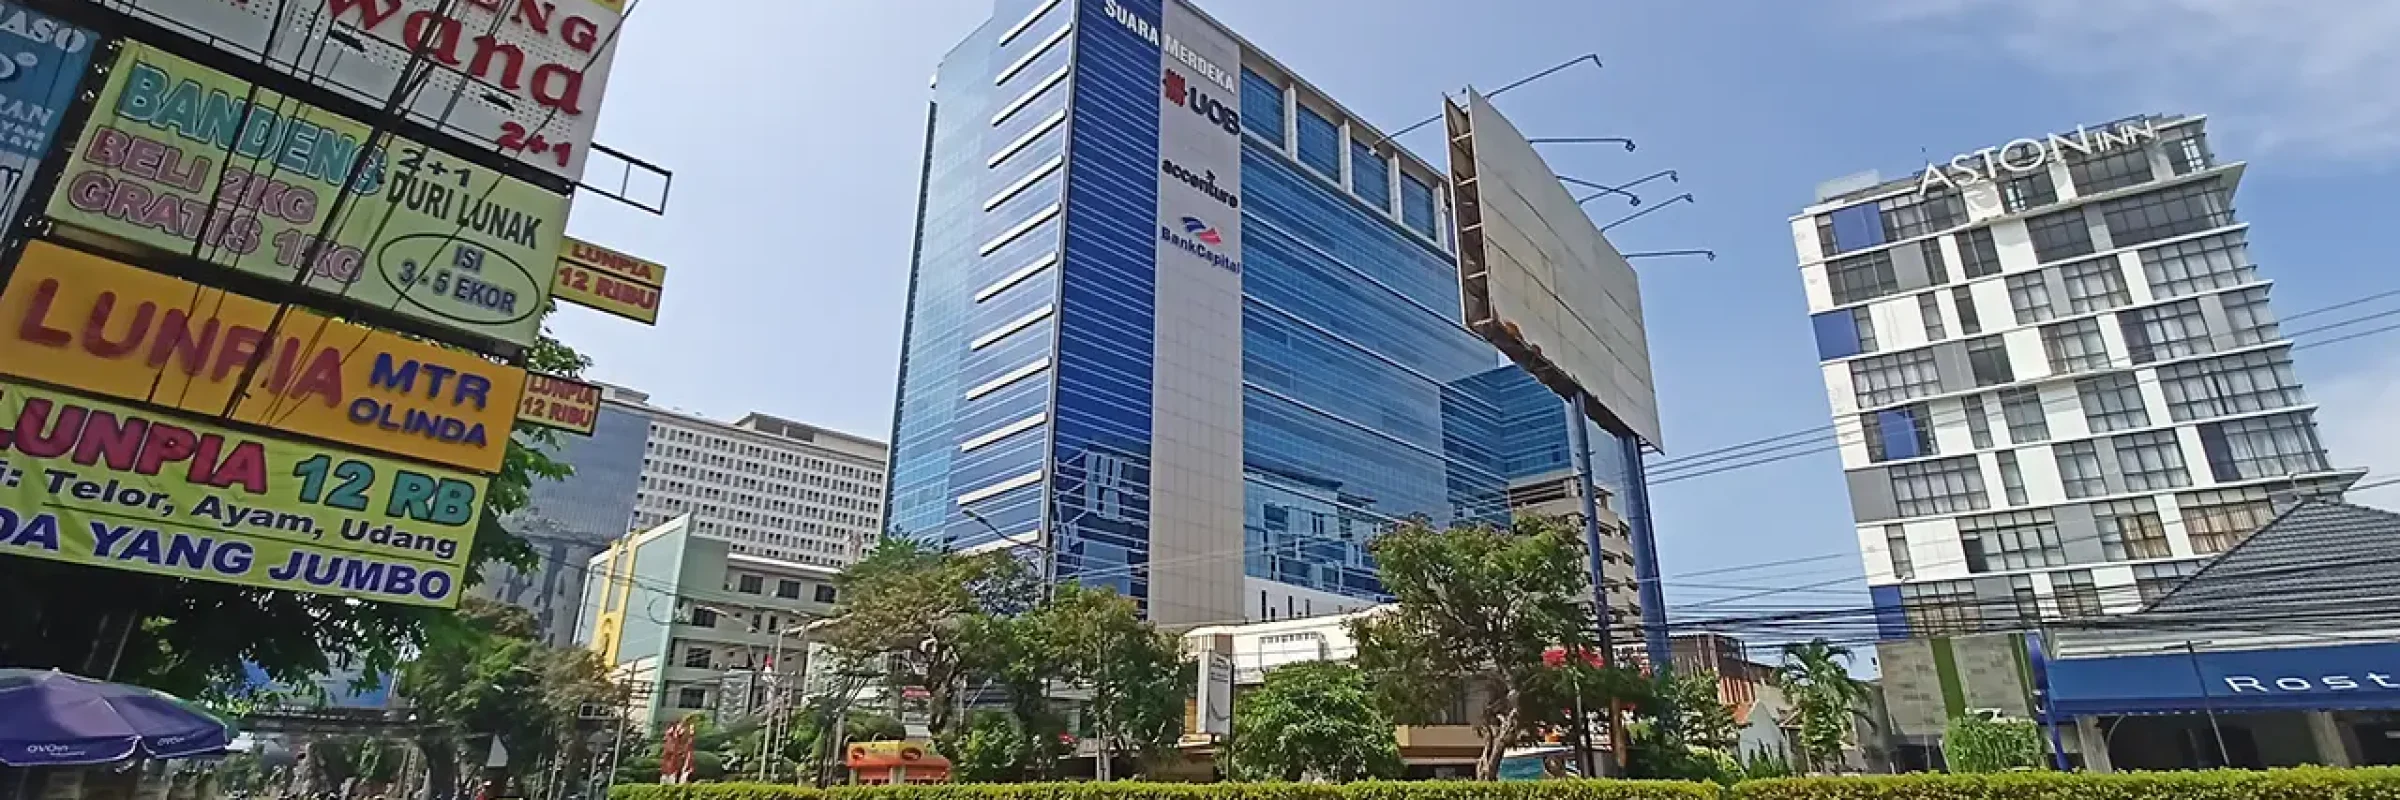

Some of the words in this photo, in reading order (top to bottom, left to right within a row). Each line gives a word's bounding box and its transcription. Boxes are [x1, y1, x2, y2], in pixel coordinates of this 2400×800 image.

[0, 5, 87, 53] ASO
[467, 0, 598, 53] NG
[1103, 0, 1159, 47] SUARA
[1163, 33, 1236, 94] MERDEKA
[114, 60, 388, 195] BANDENG
[1190, 86, 1241, 136] UOB
[398, 147, 471, 187] 2+1
[497, 121, 573, 168] 2+1
[1919, 123, 2092, 196] ASTON
[2095, 119, 2155, 153] INN
[84, 125, 212, 194] BELI
[218, 167, 318, 224] 2KG
[1162, 159, 1238, 209] accenture
[68, 169, 263, 254] GRATIS
[386, 170, 454, 220] DURI
[457, 193, 542, 250] LUNAK
[452, 245, 485, 272] ISI
[571, 243, 652, 280] LUNPIA
[1161, 225, 1241, 274] BankCapital
[398, 259, 417, 285] 3
[433, 271, 452, 295] 5
[454, 275, 517, 316] EKOR
[559, 265, 590, 293] 12
[594, 276, 658, 310] RIBU
[20, 278, 343, 409] LUNPIA
[369, 351, 492, 412] MTR
[528, 374, 594, 406] LUNPIA
[348, 396, 487, 448] OLINDA
[522, 396, 545, 417] 12
[550, 402, 593, 427] RIBU
[44, 467, 175, 518] Telor,
[190, 494, 324, 541] Ayam,
[341, 518, 458, 559] Udang
[292, 452, 375, 512] 12
[385, 469, 477, 527] RB
[90, 521, 255, 574] YANG
[268, 550, 451, 599] JUMBO
[2223, 671, 2400, 693] Rost
